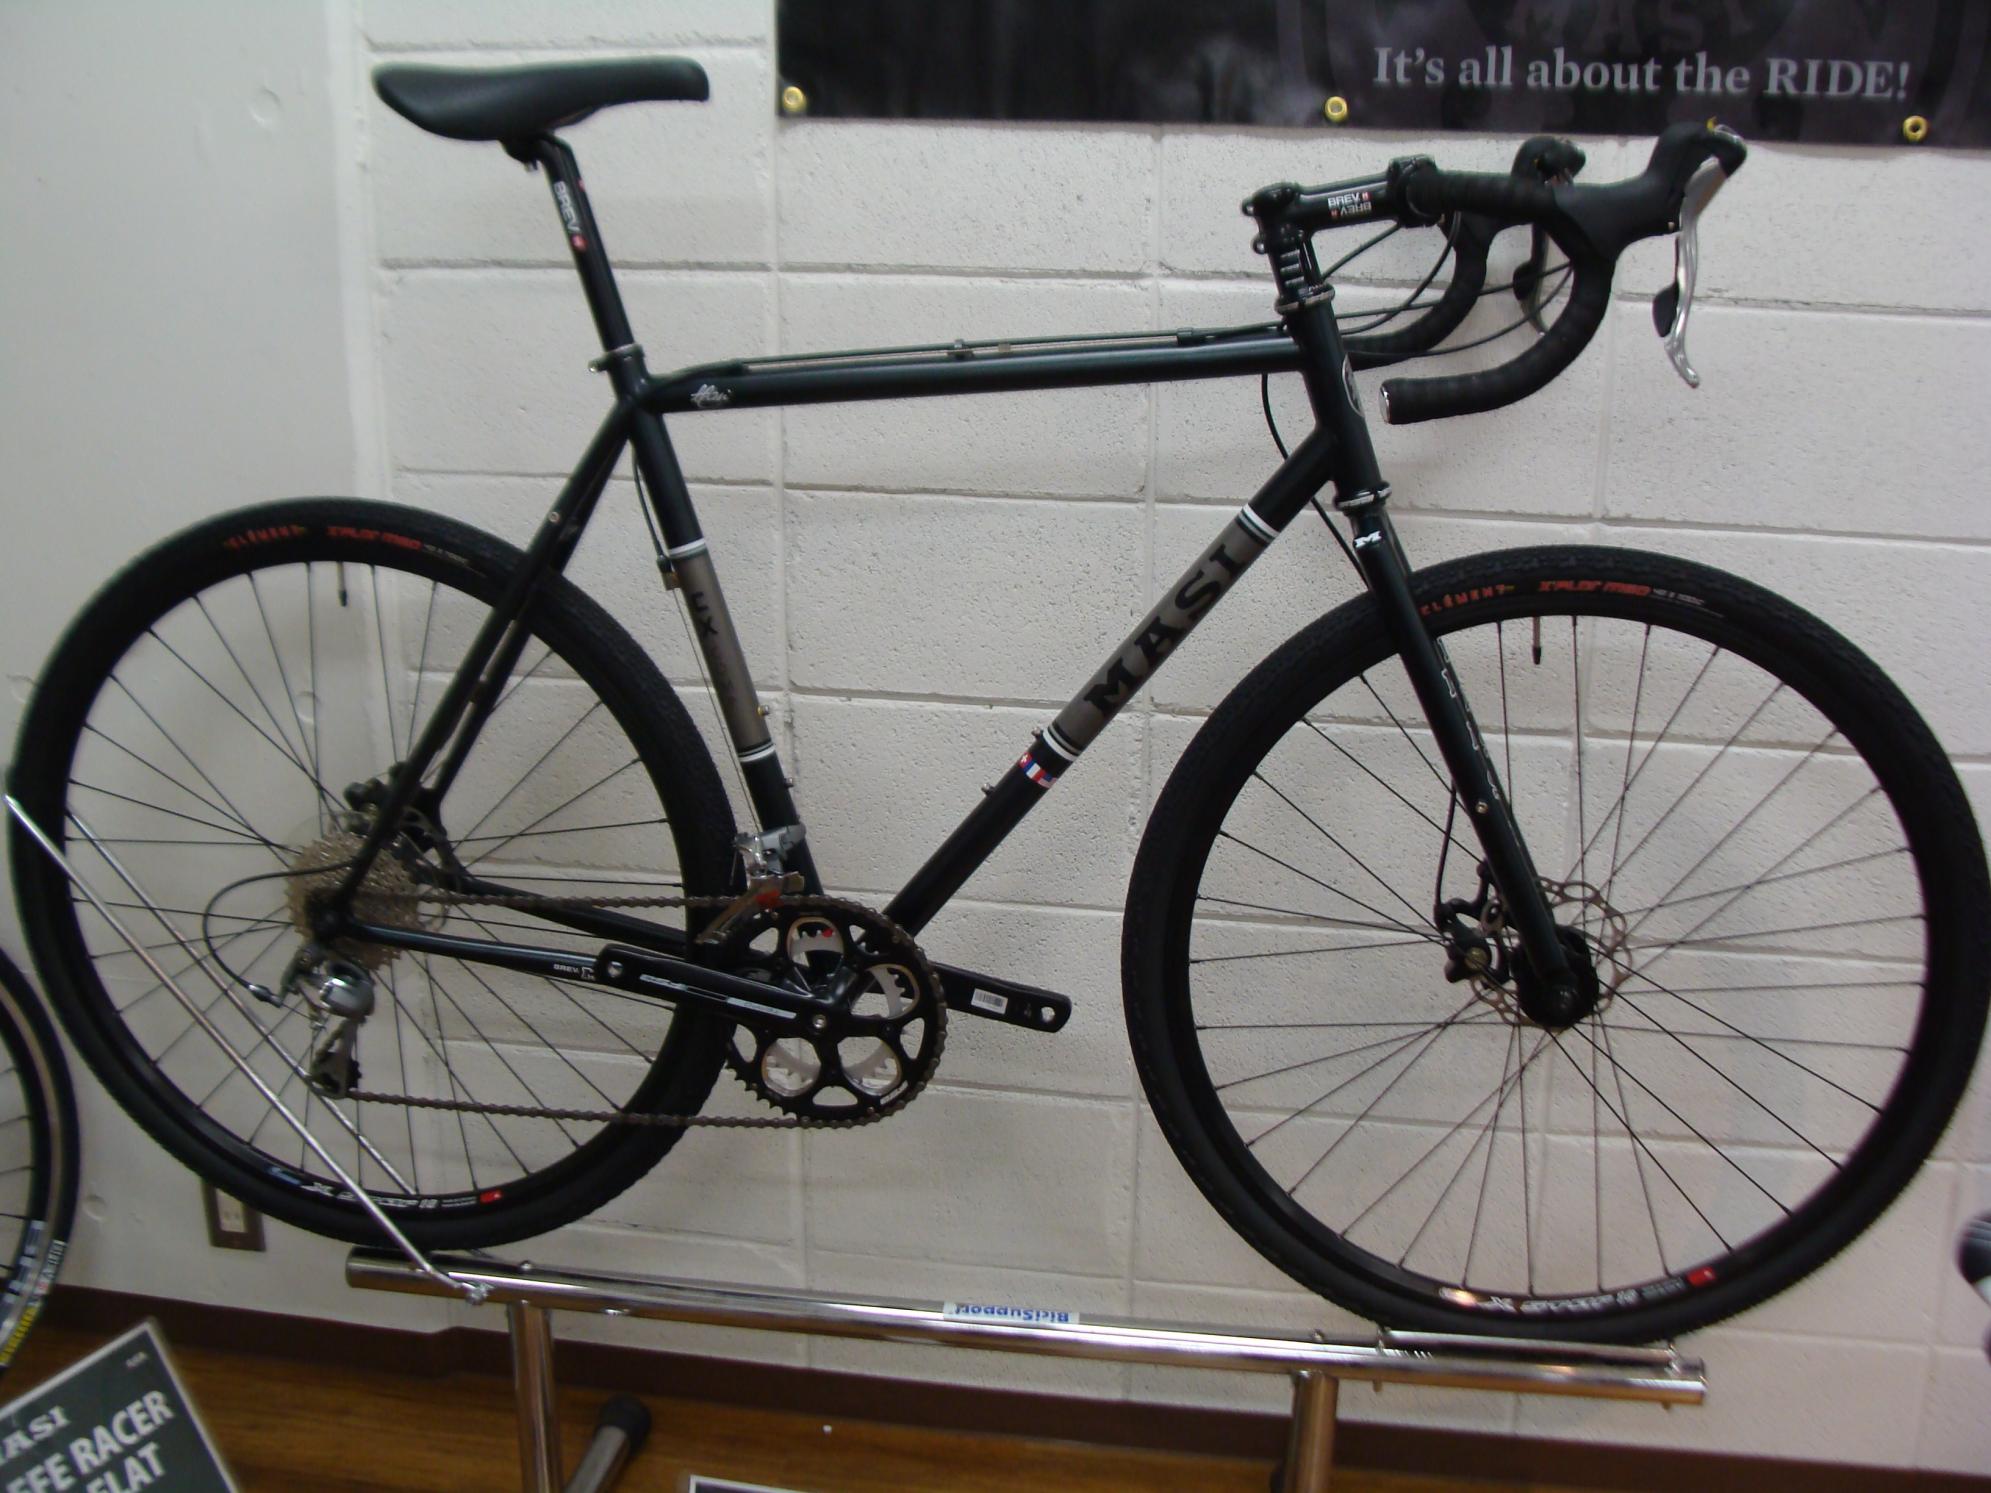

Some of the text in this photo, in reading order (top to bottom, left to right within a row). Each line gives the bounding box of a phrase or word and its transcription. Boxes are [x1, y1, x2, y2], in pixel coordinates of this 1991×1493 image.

[1458, 45, 1512, 87] all
[1527, 47, 1662, 91] about
[1674, 51, 1750, 93] the
[1763, 57, 1910, 99] RIDE!
[1084, 544, 1249, 714] MASI
[0, 1405, 71, 1467] ASI
[69, 1390, 175, 1476] RACER
